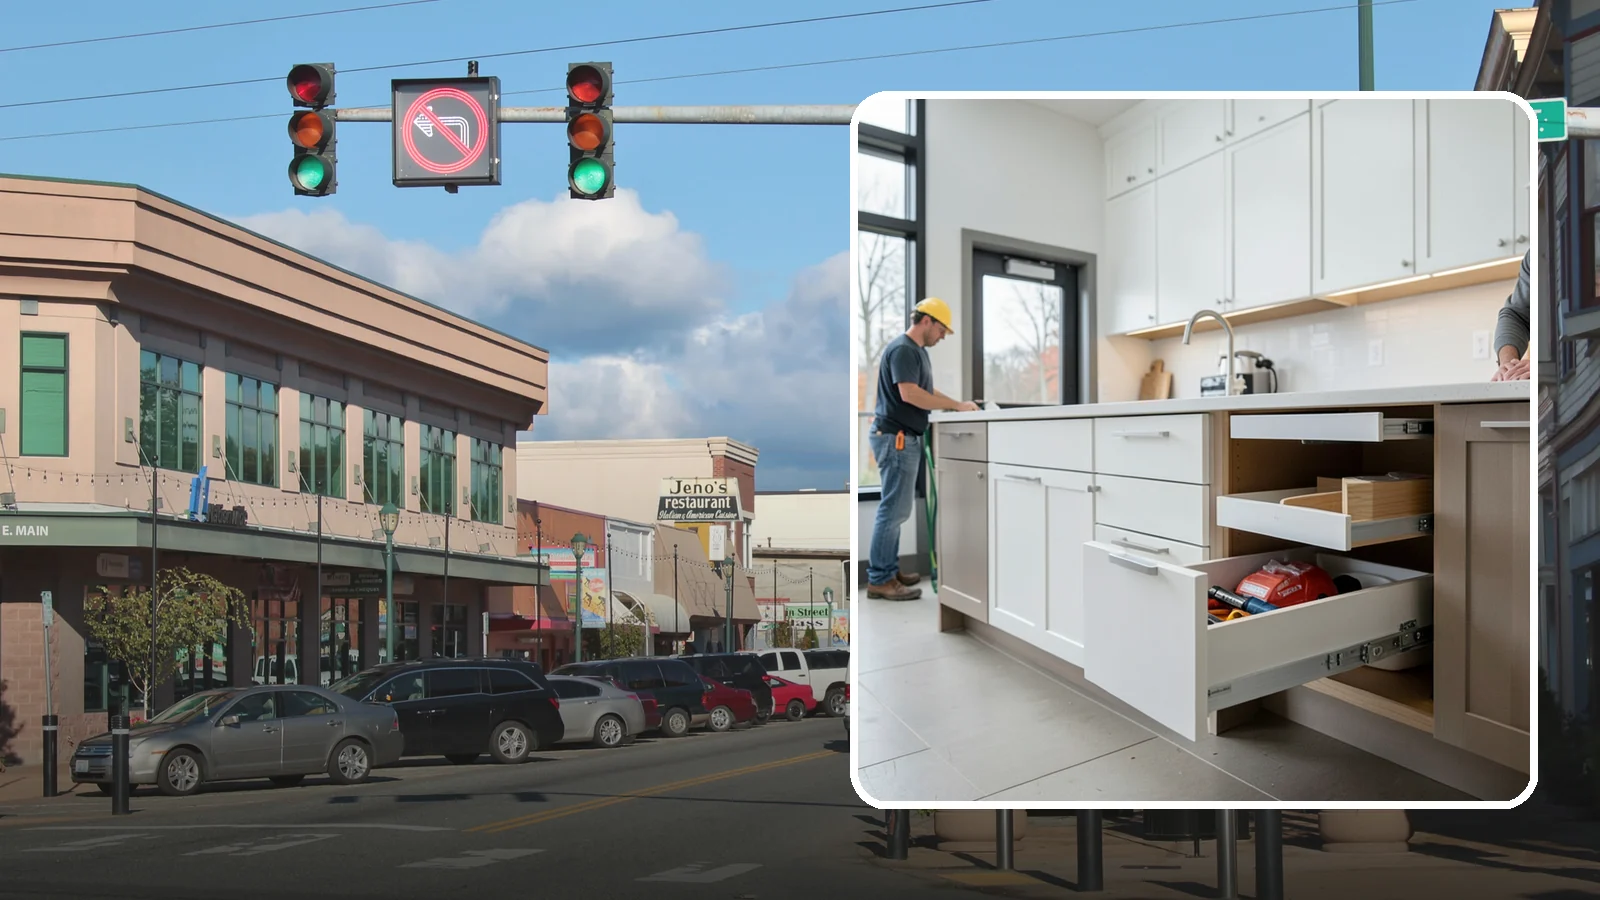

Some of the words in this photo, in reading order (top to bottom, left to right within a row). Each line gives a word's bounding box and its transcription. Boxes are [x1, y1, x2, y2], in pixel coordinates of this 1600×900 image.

[670, 480, 727, 494] Jeno's
[665, 496, 731, 509] restaurant
[659, 510, 682, 519] Italian
[686, 510, 714, 519] American
[715, 509, 737, 519] Cuisine
[2, 525, 13, 536] E.
[16, 525, 49, 536] MAIN
[797, 607, 828, 617] Street
[791, 619, 823, 627] lass
